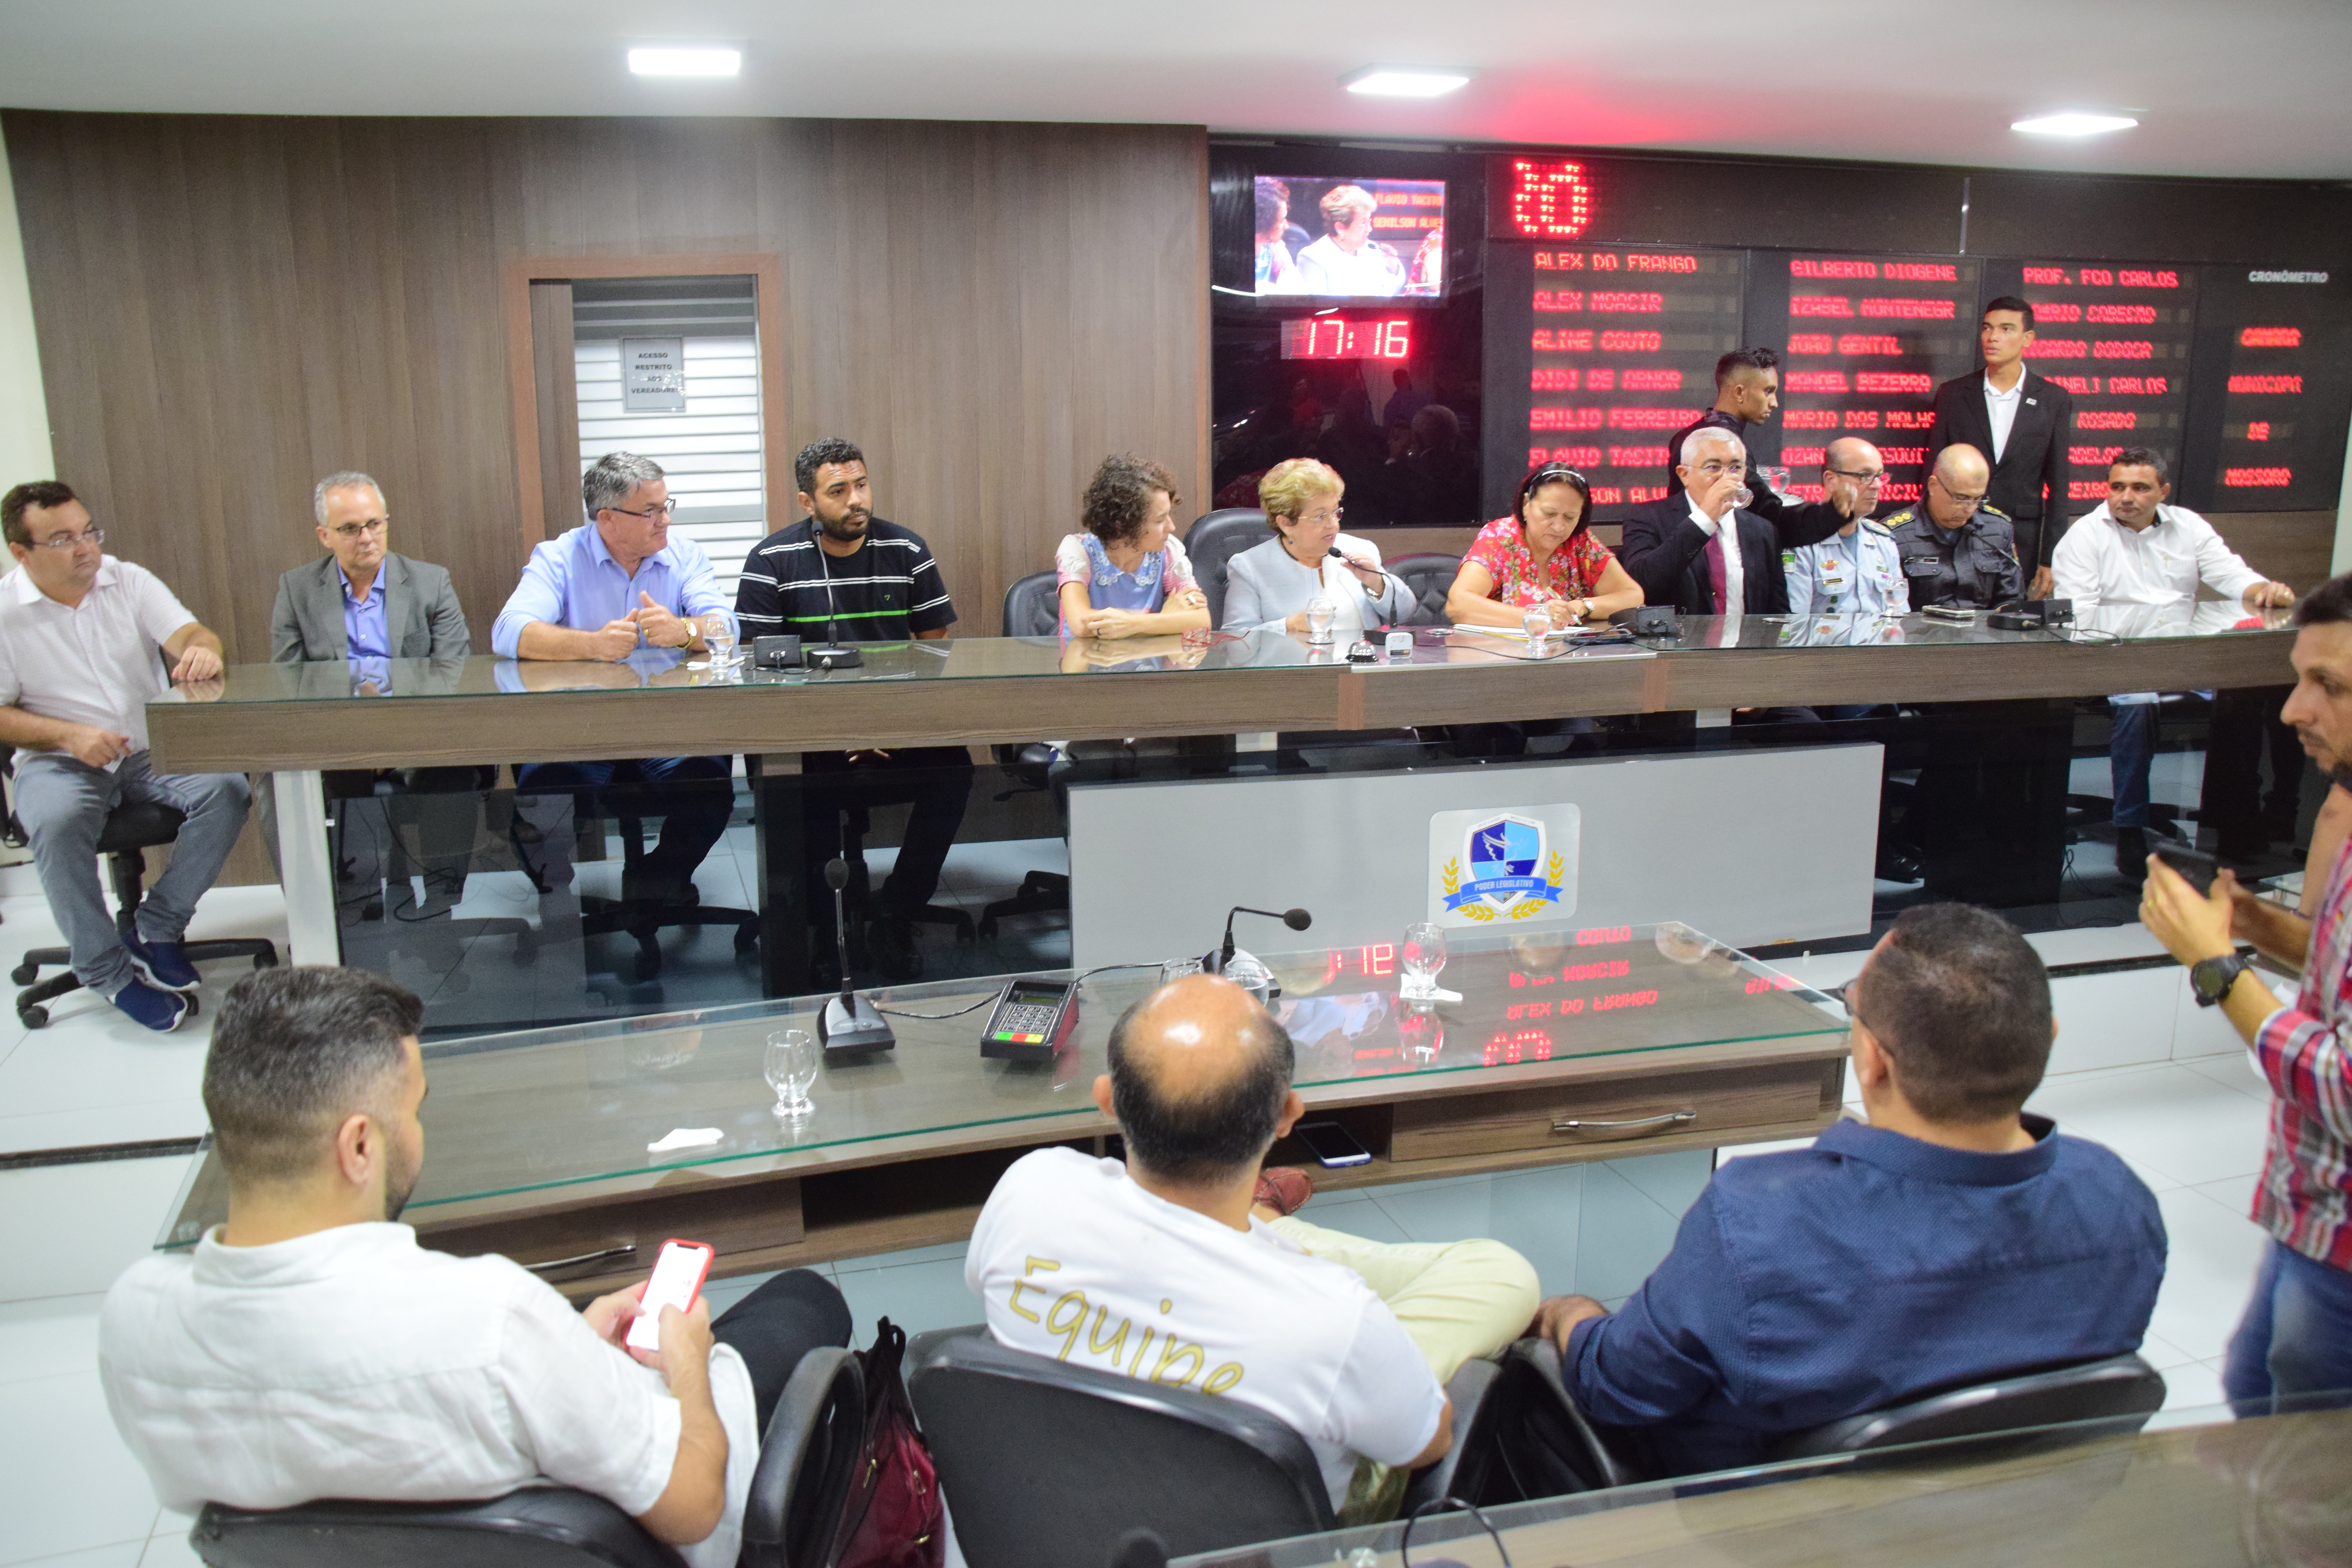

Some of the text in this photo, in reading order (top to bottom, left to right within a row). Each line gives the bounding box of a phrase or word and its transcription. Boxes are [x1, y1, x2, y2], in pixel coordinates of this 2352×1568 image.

[1534, 252, 1698, 273] ALEX DO FRANGO
[1790, 260, 1957, 281] GILBERTO DIOGENE
[2023, 267, 2180, 288] PROF. FCO CARLOS
[1532, 291, 1663, 312] ALEX MOACIR
[1308, 320, 1408, 357] 17:16
[1532, 328, 1662, 352] ALINE COUTO
[1838, 334, 1903, 355] GENTIL
[1530, 369, 1579, 390] DIDI
[1587, 369, 1615, 390] DE
[1530, 408, 1604, 430] EMILIO
[2078, 412, 2137, 430] ROSADO
[1608, 447, 1670, 466] TACIT
[1780, 446, 1826, 465] OZAN
[1474, 879, 1534, 892] PODER LEGISLATIVO
[1010, 1255, 1244, 1394] Equipe
